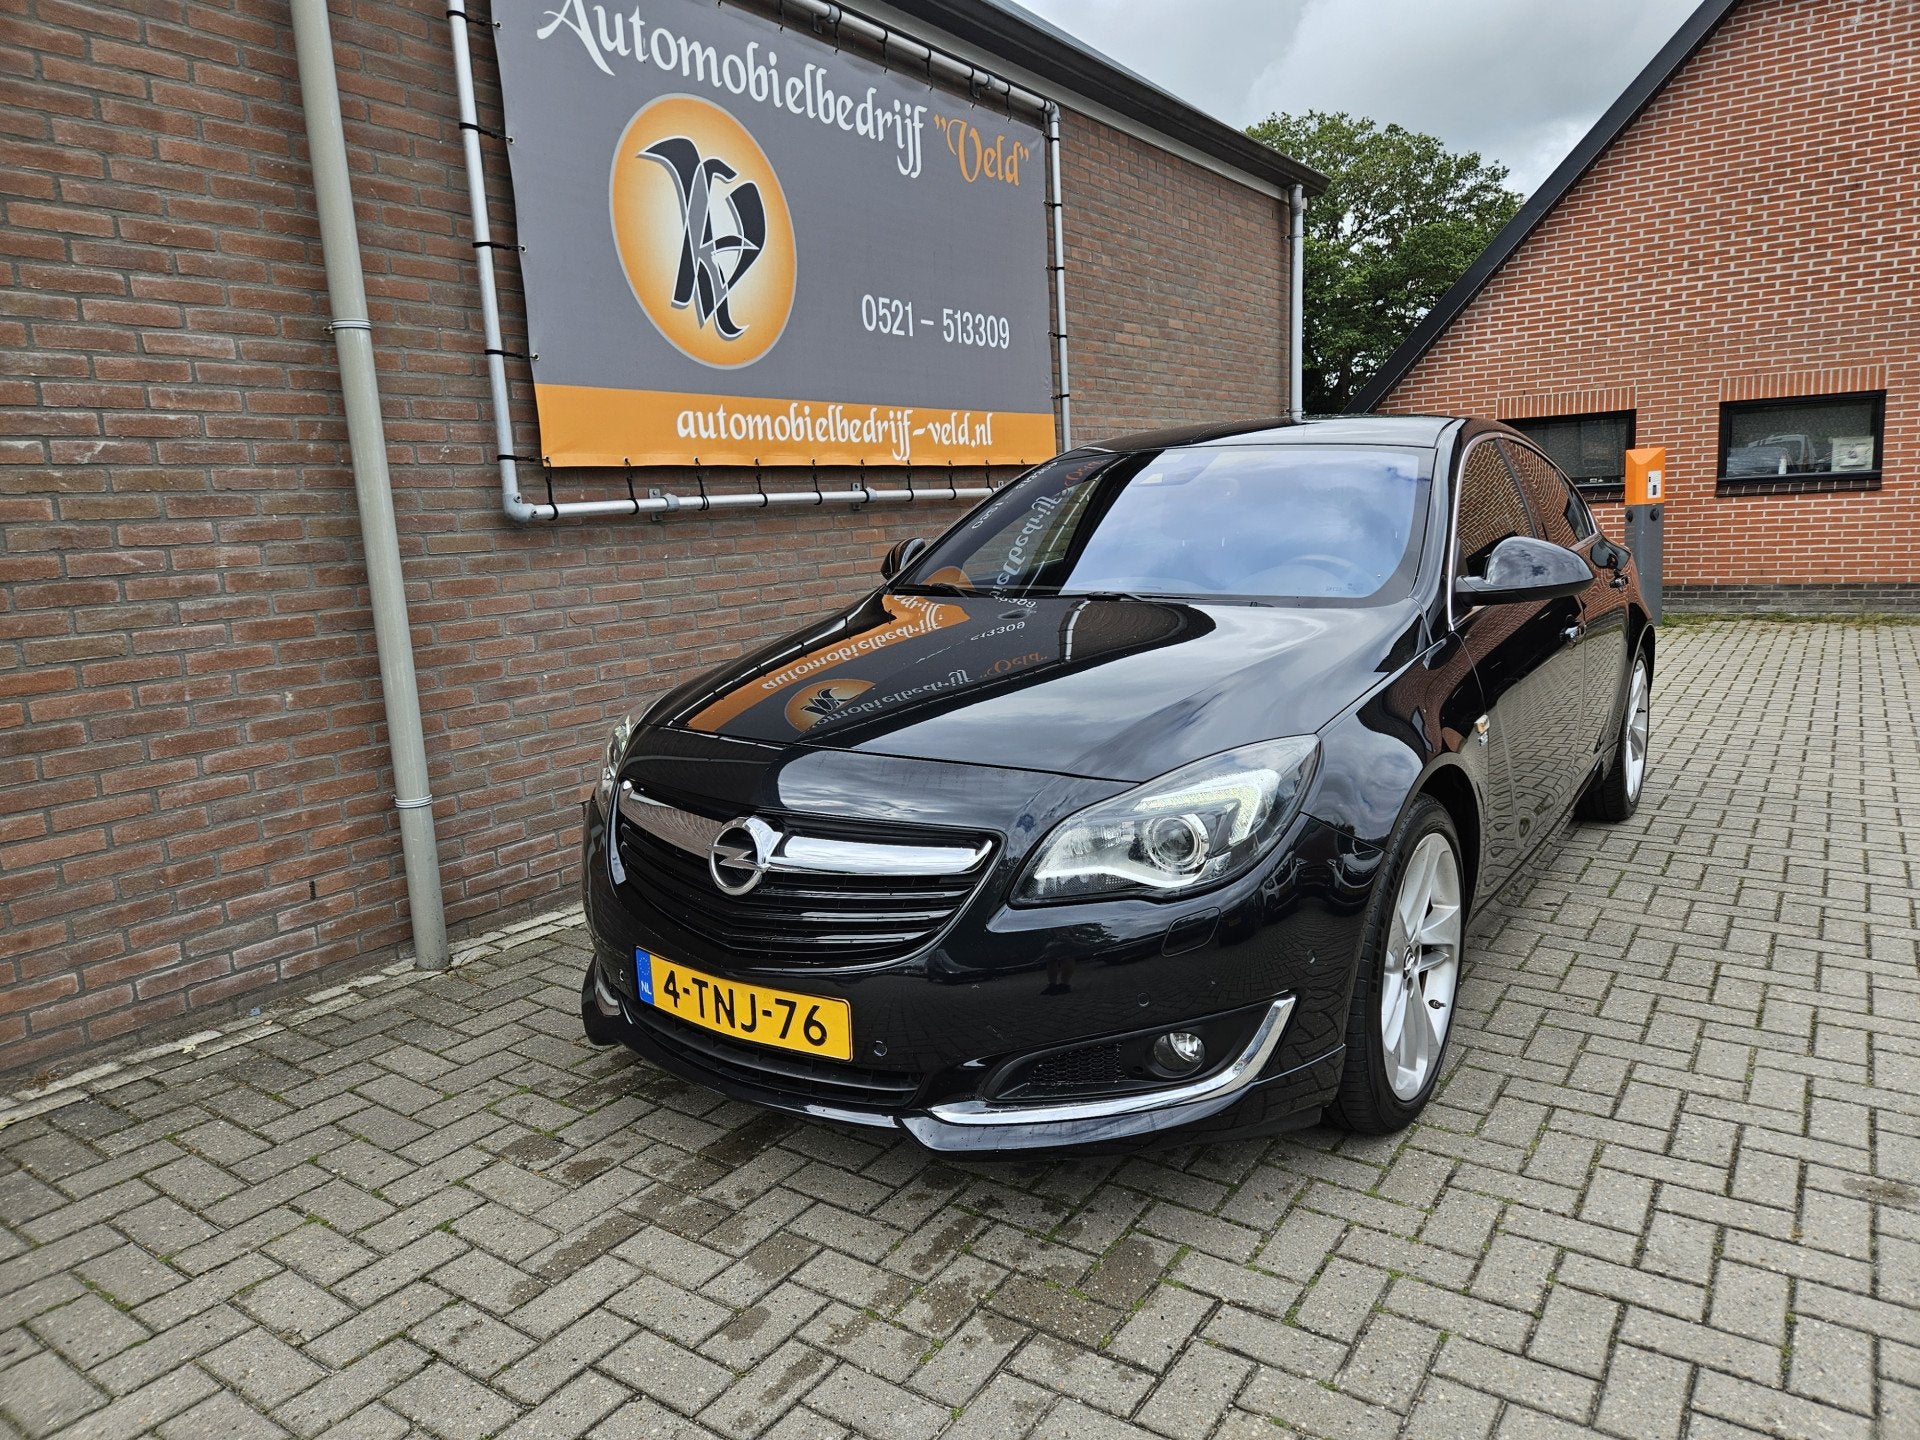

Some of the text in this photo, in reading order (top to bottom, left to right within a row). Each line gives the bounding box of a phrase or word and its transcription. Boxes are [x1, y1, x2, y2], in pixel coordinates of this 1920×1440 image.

[536, 0, 1029, 187] Automobielbedrijf "Veld"
[861, 294, 914, 337] 0521
[943, 308, 1010, 350] 513309
[677, 402, 994, 461] automobielbedrijf-veld.nl
[640, 980, 652, 995] NL
[663, 969, 828, 1047] 4-TNJ-76
